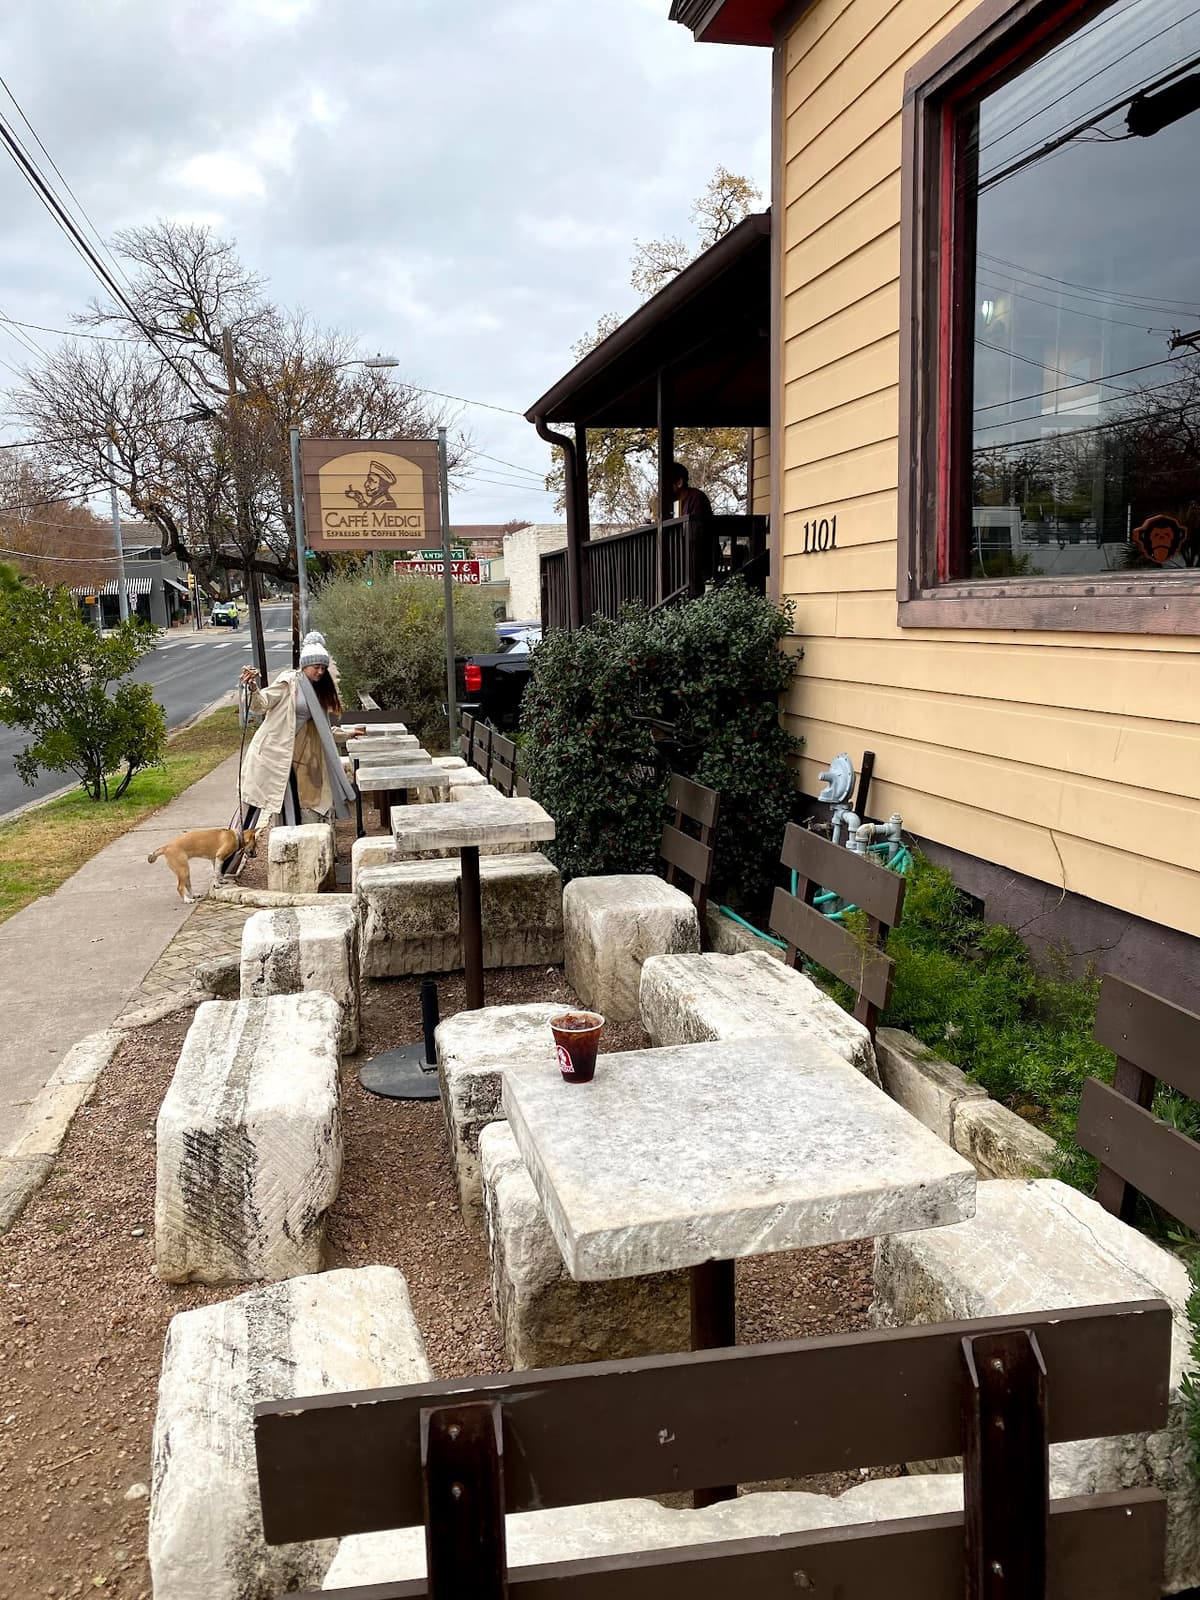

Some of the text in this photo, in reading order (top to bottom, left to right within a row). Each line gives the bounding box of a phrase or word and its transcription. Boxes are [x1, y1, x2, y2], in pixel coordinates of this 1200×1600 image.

[325, 511, 421, 528] CAFFÉ MEDICI
[326, 529, 422, 537] ESPRESSO & COFFEE HOUSE
[802, 514, 838, 554] 1101
[407, 563, 459, 572] LAUNDY
[425, 573, 478, 582] ENING
